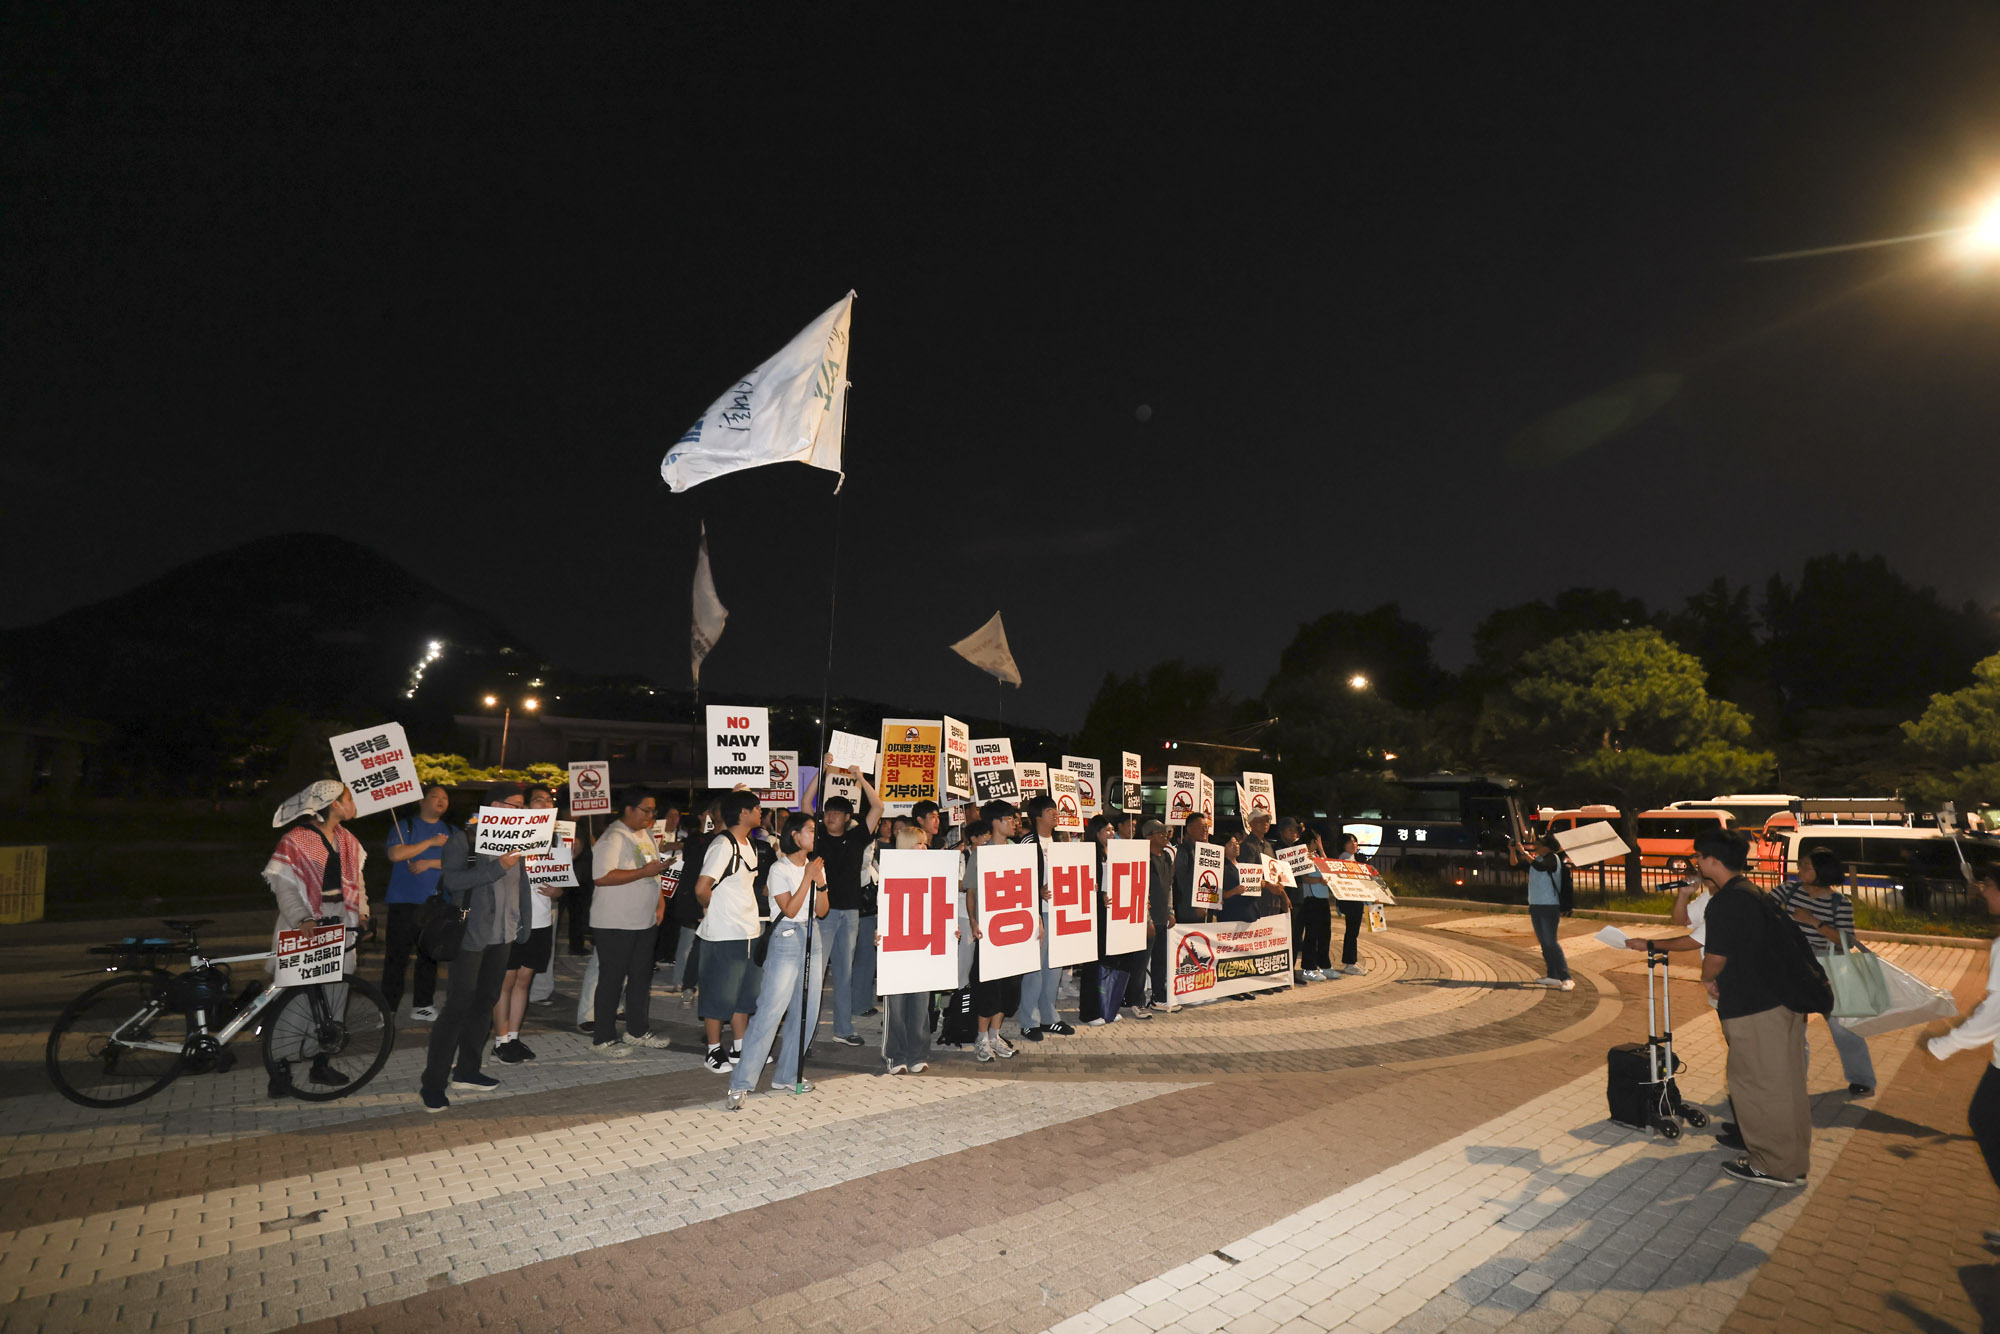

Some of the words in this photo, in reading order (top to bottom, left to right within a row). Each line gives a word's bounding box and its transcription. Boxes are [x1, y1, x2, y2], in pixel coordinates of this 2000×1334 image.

[727, 716, 750, 729] NO
[950, 725, 964, 740] 정부는
[717, 734, 760, 747] NAVY
[948, 738, 958, 751] 파병
[958, 741, 966, 754] 요구
[340, 734, 391, 762] 침략을
[887, 744, 912, 752] 이재명
[913, 744, 936, 753] 정부는
[976, 744, 1000, 754] 미국의
[360, 748, 404, 770] 멈춰라!
[732, 752, 746, 762] TO
[887, 754, 936, 768] 침략전쟁
[972, 756, 990, 766] 파병
[991, 755, 1008, 766] 압박
[714, 766, 764, 776] HORMUZ!
[948, 758, 962, 772] 거부
[1068, 760, 1094, 770] 파병논의
[350, 766, 400, 794] 전쟁을
[887, 769, 900, 782] 참
[922, 769, 934, 782] 전
[977, 772, 1000, 786] 규탄
[1024, 769, 1040, 778] 정부는
[770, 781, 792, 790] 르무즈
[832, 776, 858, 786] NAVY
[1020, 779, 1033, 787] 파병
[1033, 779, 1044, 787] 요구
[370, 780, 414, 801] 멈춰라!
[761, 791, 794, 800] 파병반대
[885, 784, 934, 798] 거부하라
[988, 782, 1016, 798] 한다!
[1021, 790, 1037, 800] 거부
[1124, 784, 1134, 796] 거부
[482, 815, 499, 824] DO
[500, 816, 524, 825] NOT
[525, 814, 550, 824] JOIN
[480, 828, 489, 837] A
[492, 830, 520, 839] WAR
[522, 829, 536, 838] OF
[1398, 828, 1428, 842] 경찰
[480, 840, 550, 853] AGGRESSION!
[1200, 848, 1220, 858] 파병논의
[526, 853, 555, 861] NAVAL
[1199, 857, 1221, 868] 중단하라!
[525, 864, 570, 874] PLOYMENT
[530, 875, 570, 884] HORMUZ!
[882, 876, 954, 956] 파
[984, 868, 1034, 947] 병
[1052, 865, 1094, 936] 반
[1112, 861, 1147, 924] 대
[279, 936, 308, 954] 규탄!
[303, 946, 341, 964] 파병압박
[279, 955, 300, 970] 굴복
[1218, 959, 1256, 978] 파병반대
[1255, 953, 1288, 974] 평화행진
[298, 961, 340, 980] 대미투자,
[1176, 970, 1214, 993] 파병반대
